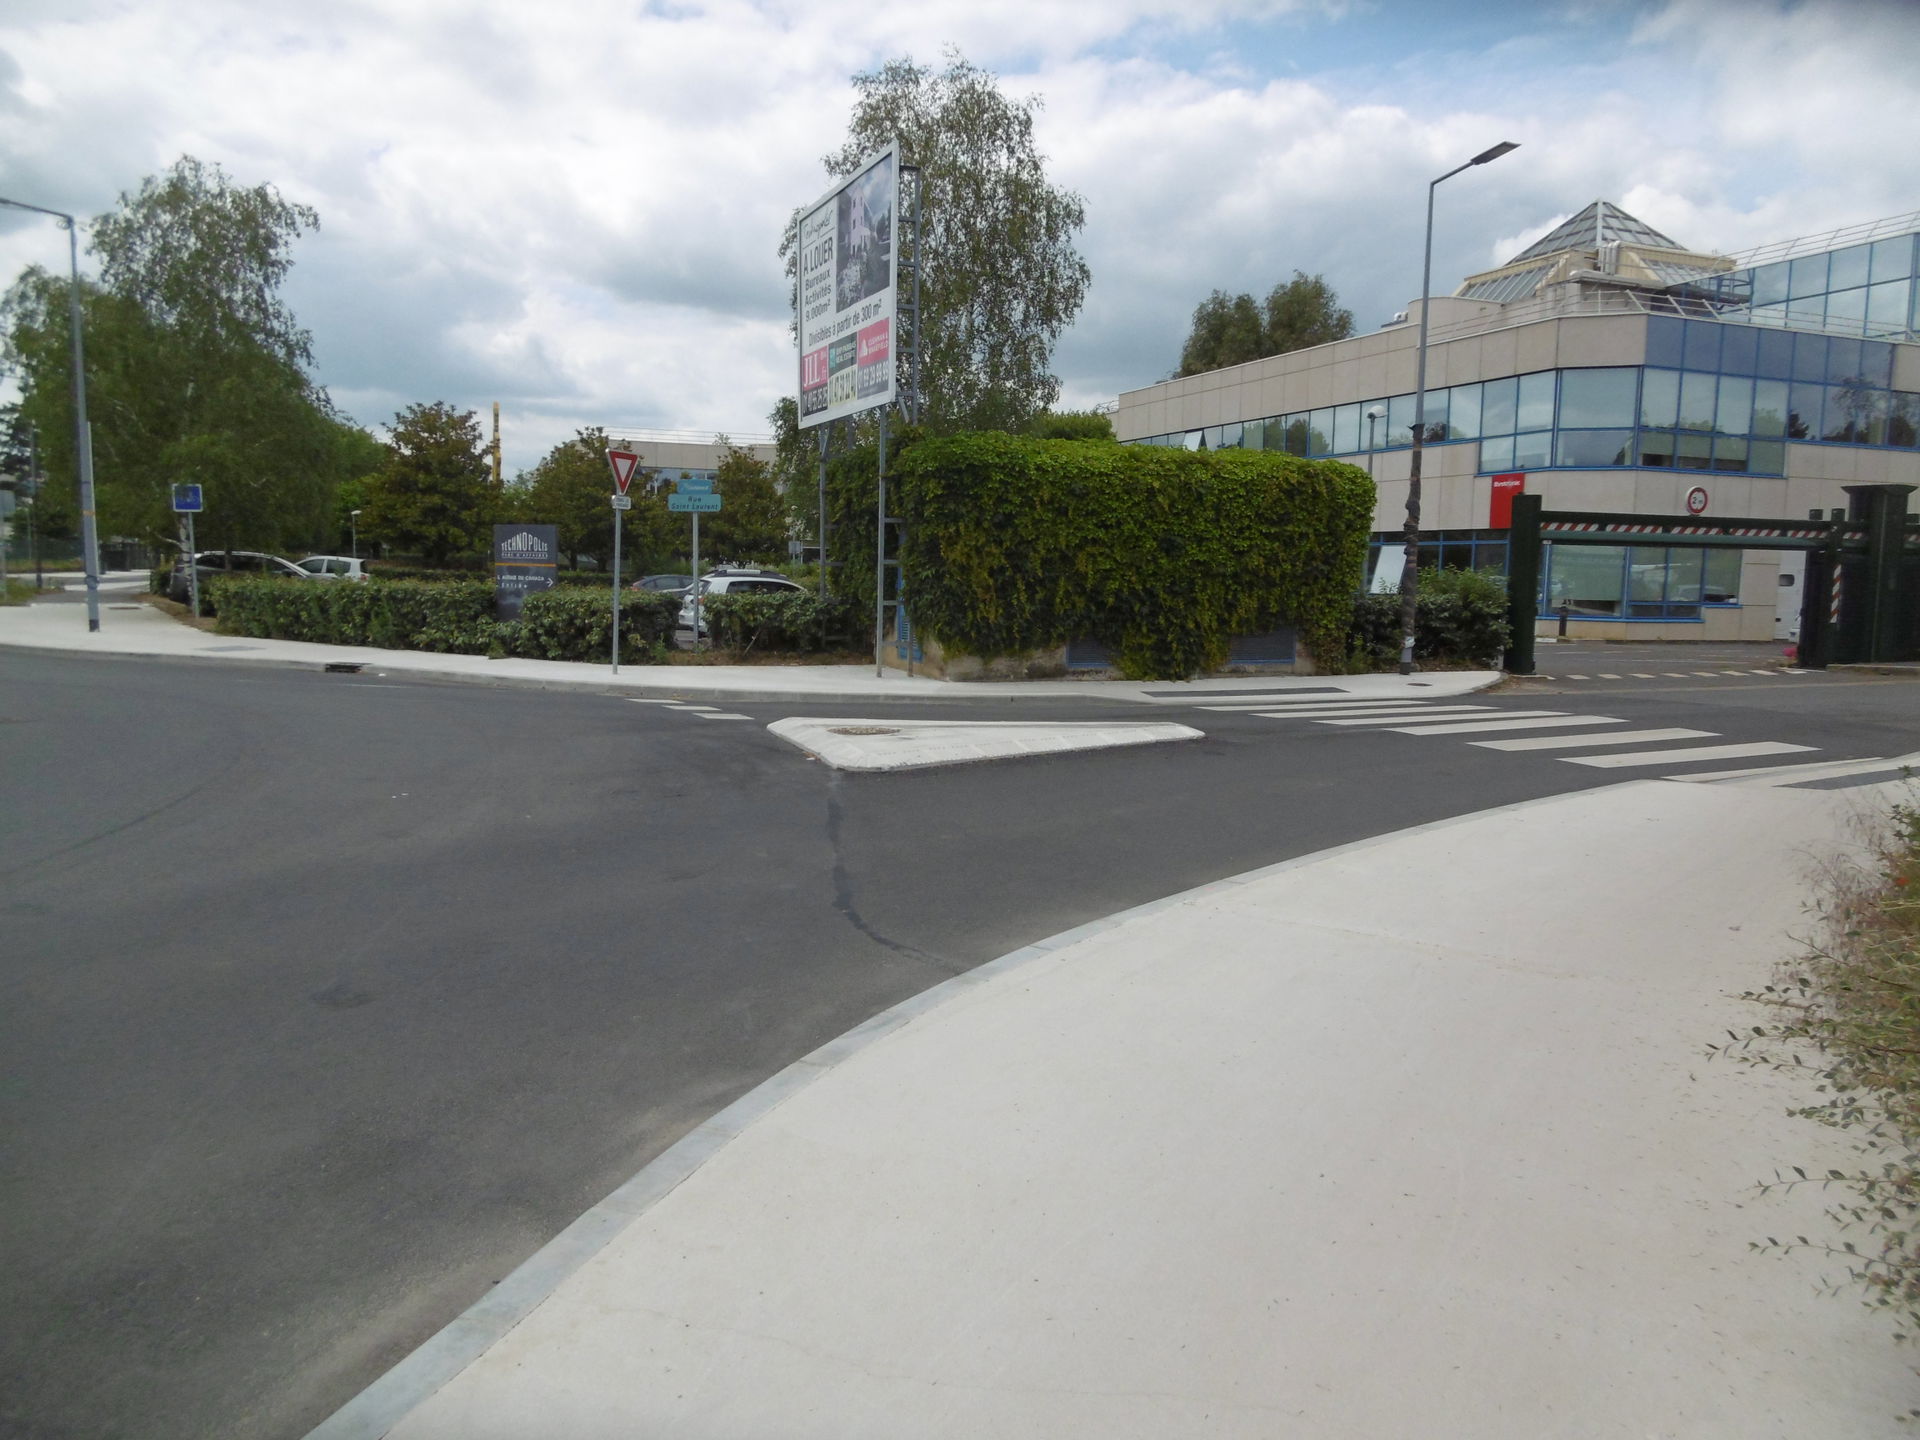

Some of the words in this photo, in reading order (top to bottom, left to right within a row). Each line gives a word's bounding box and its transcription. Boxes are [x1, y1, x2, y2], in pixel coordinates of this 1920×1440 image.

[803, 253, 809, 277] A
[810, 237, 833, 273] LOUER
[805, 269, 830, 291] Bureaux
[804, 285, 832, 307] Activités
[809, 326, 832, 347] Divisibles
[837, 315, 852, 336] partir
[852, 311, 860, 326] de
[861, 304, 872, 322] 300
[803, 353, 821, 388] JLL
[501, 532, 548, 552] TECHNOPOLIS
